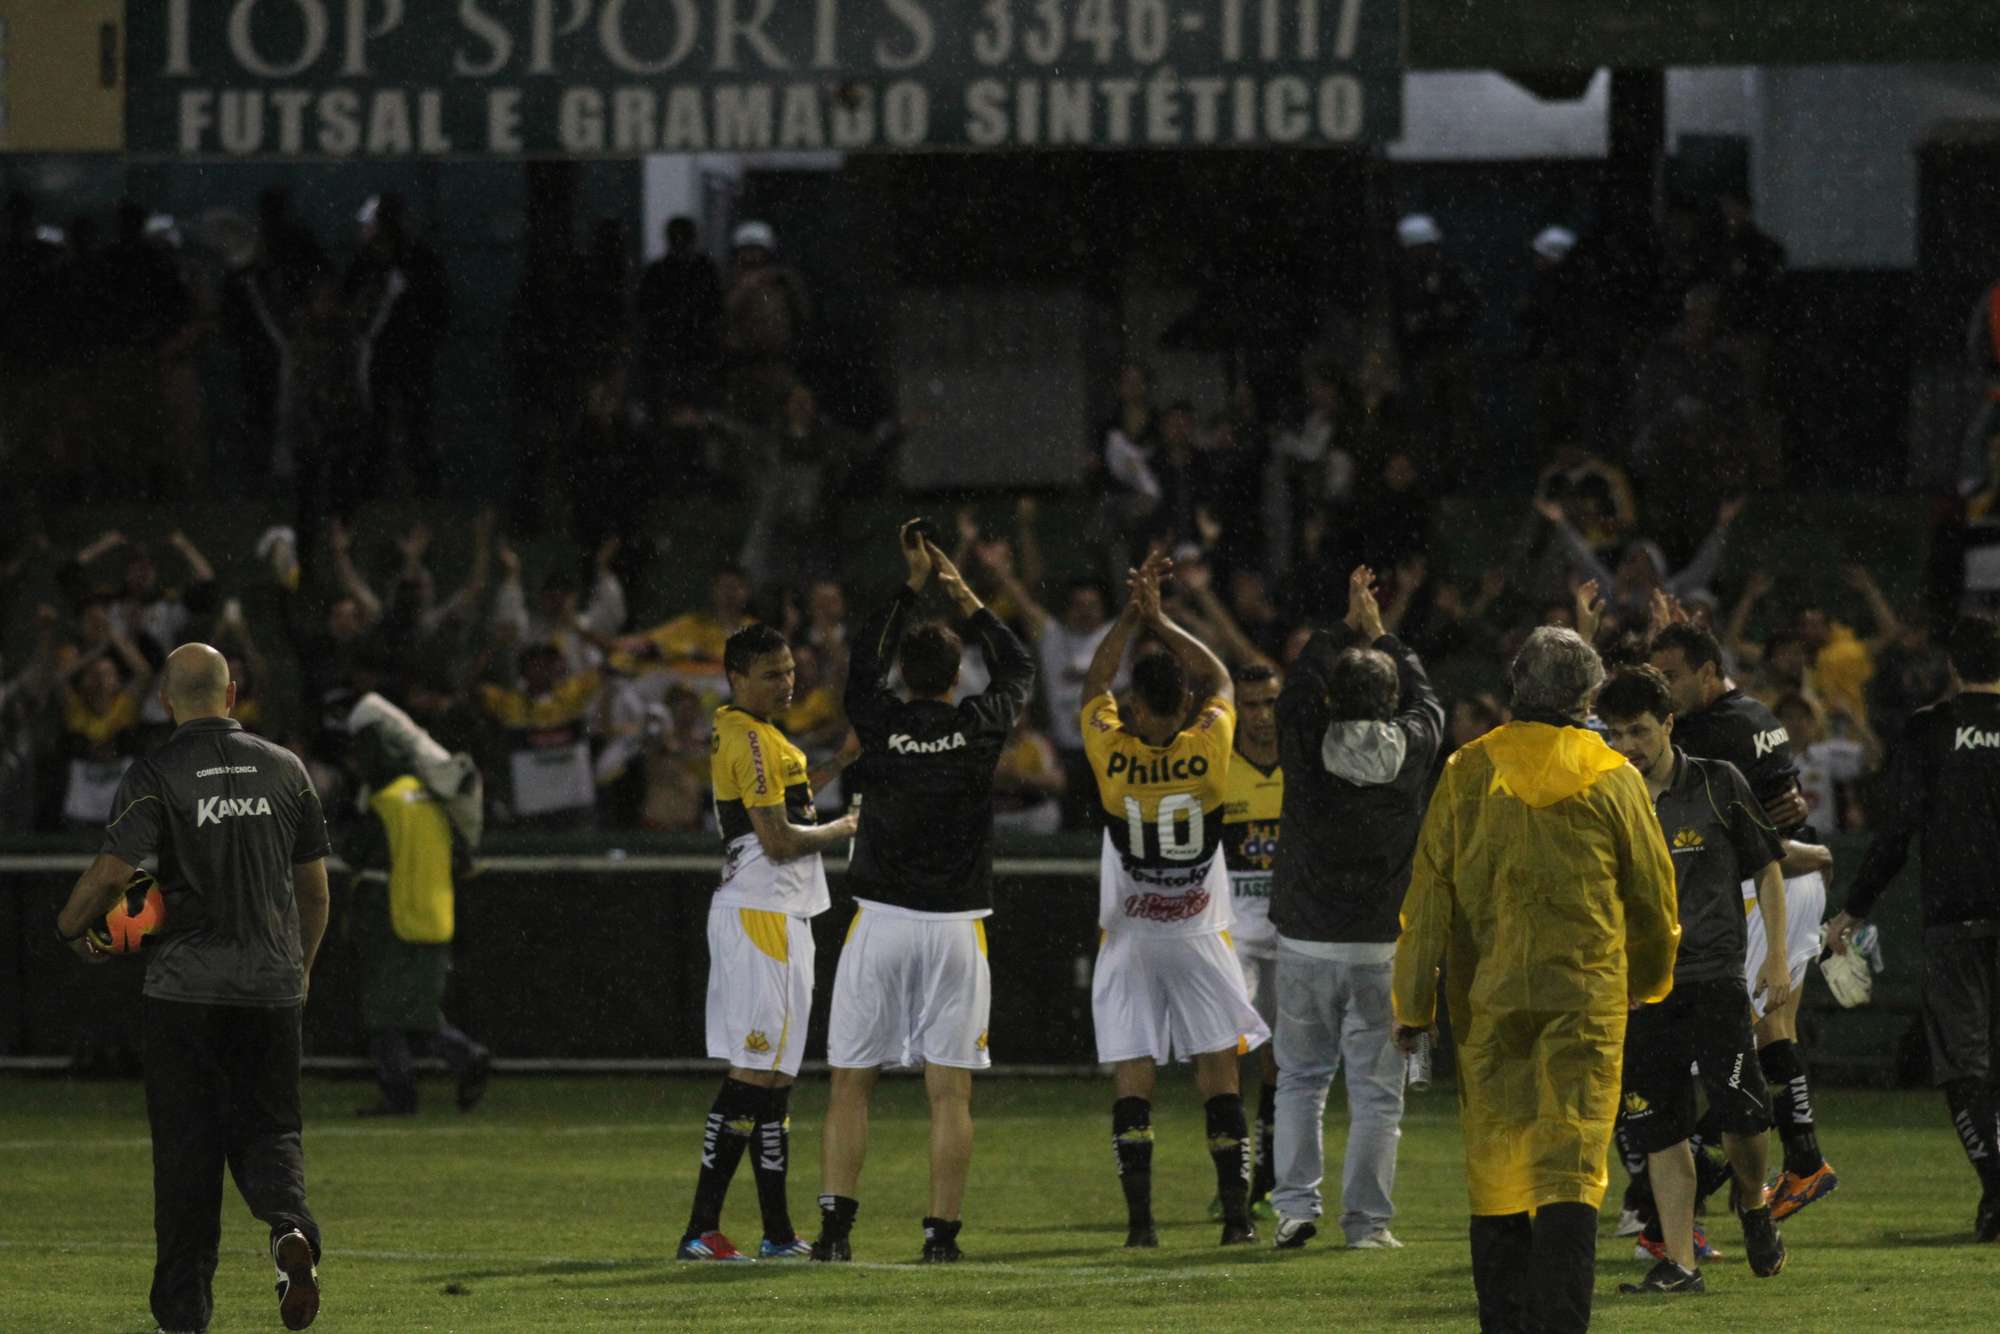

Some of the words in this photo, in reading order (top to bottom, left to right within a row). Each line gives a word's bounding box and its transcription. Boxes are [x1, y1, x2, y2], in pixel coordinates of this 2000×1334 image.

[179, 86, 452, 153] FUTSAL
[488, 86, 523, 153] E
[559, 82, 930, 152] GRAMADO
[965, 69, 1363, 144] SINTÉTICO
[888, 732, 967, 754] KANXA
[1107, 752, 1208, 784] Philco
[197, 796, 272, 828] KANXA
[1123, 793, 1204, 860] 10
